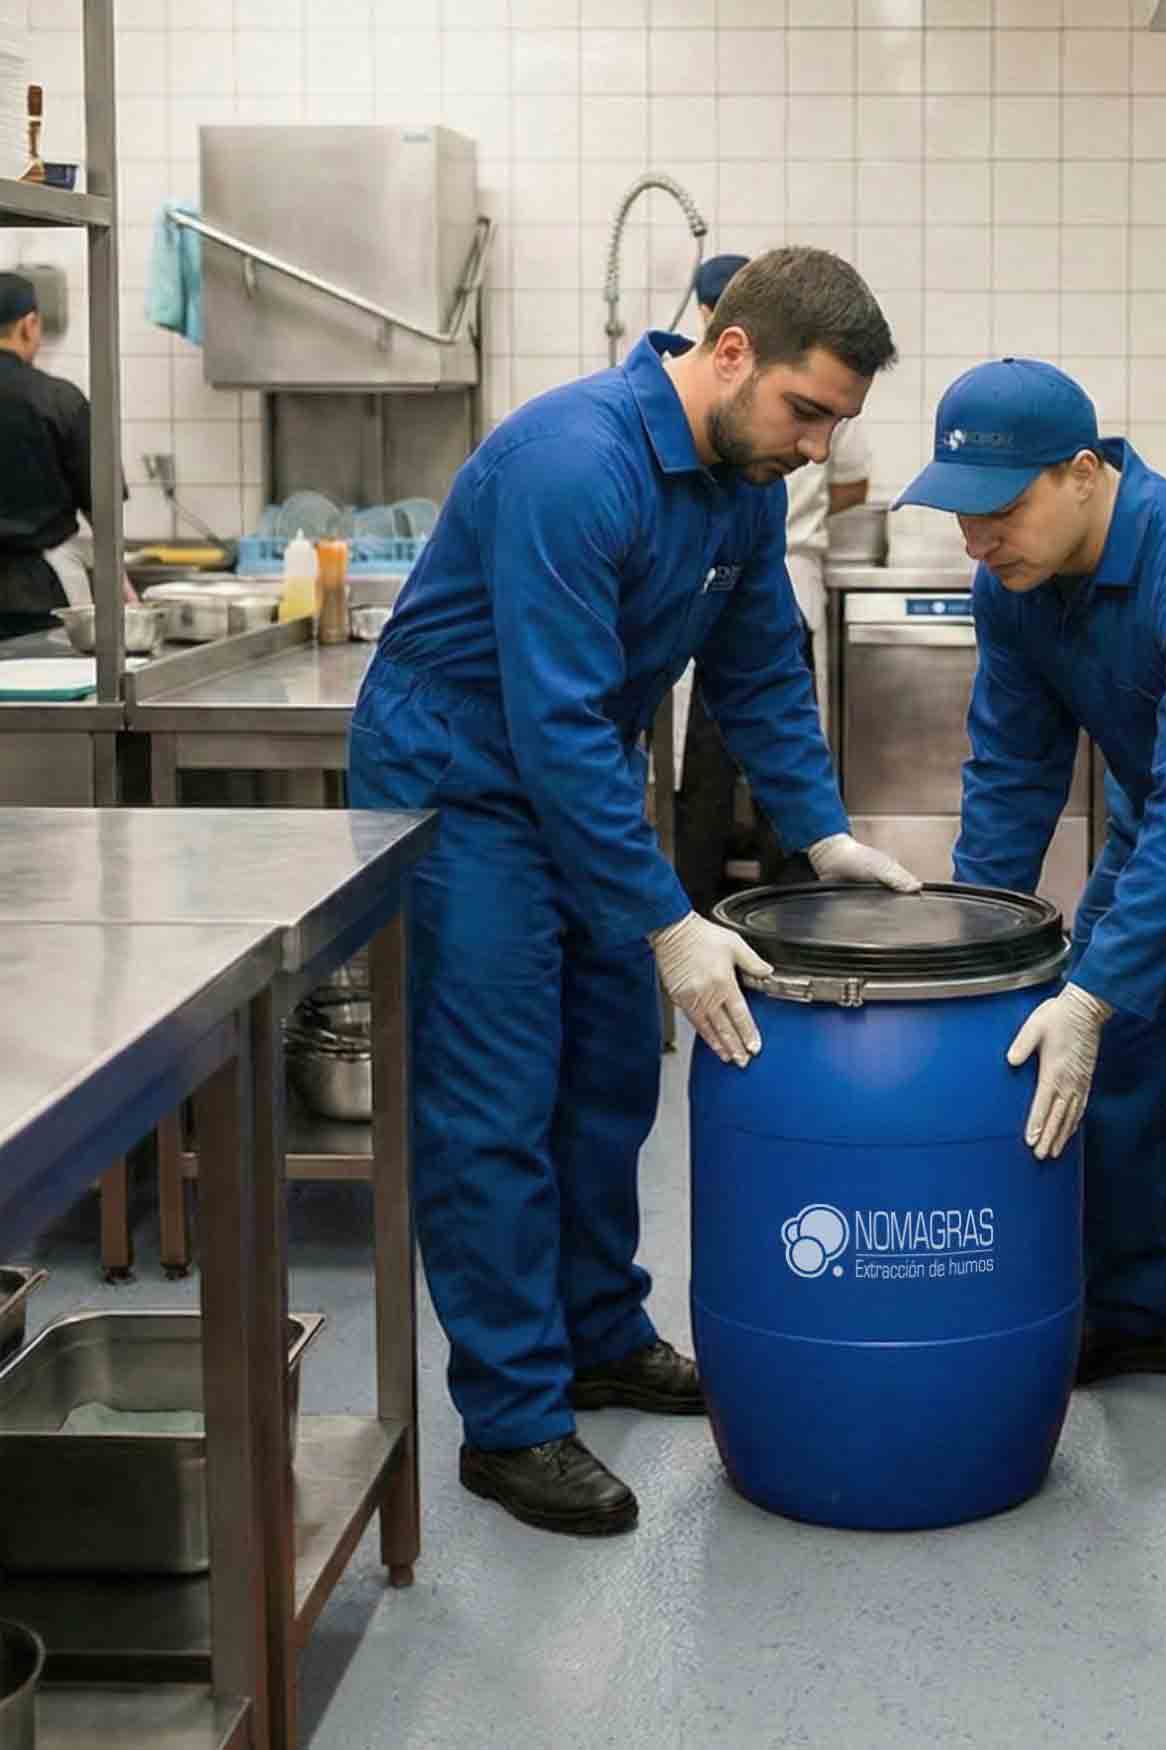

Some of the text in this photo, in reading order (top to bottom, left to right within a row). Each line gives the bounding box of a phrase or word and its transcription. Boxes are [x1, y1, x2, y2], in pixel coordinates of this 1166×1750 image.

[855, 1208, 994, 1250] NOMAGRAS
[855, 1257, 994, 1279] Extracción de humos
